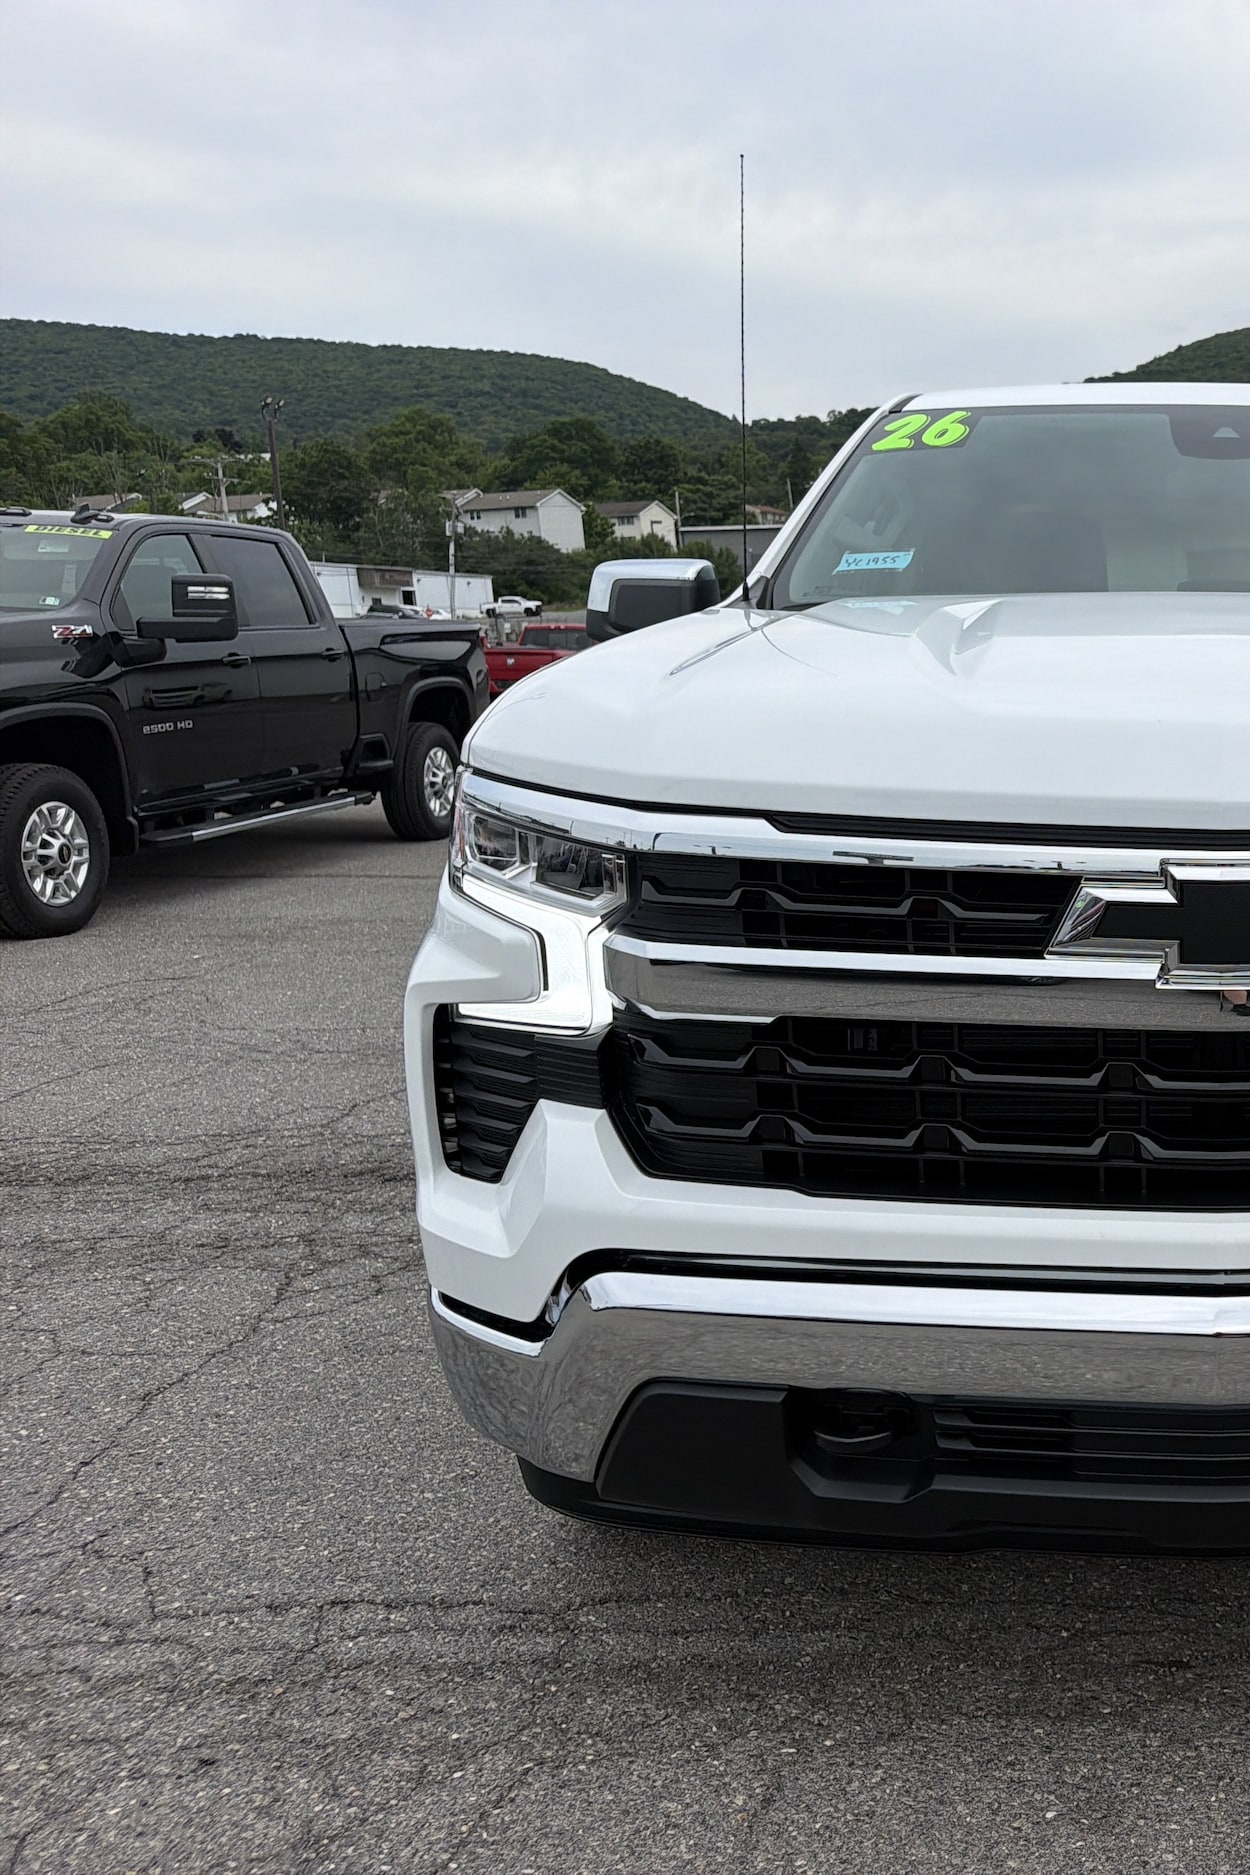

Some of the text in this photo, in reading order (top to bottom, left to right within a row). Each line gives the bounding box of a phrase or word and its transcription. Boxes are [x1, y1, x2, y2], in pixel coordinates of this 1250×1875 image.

[872, 411, 971, 451] 26
[33, 526, 103, 537] DIESEL
[143, 719, 194, 735] 2500 HD
